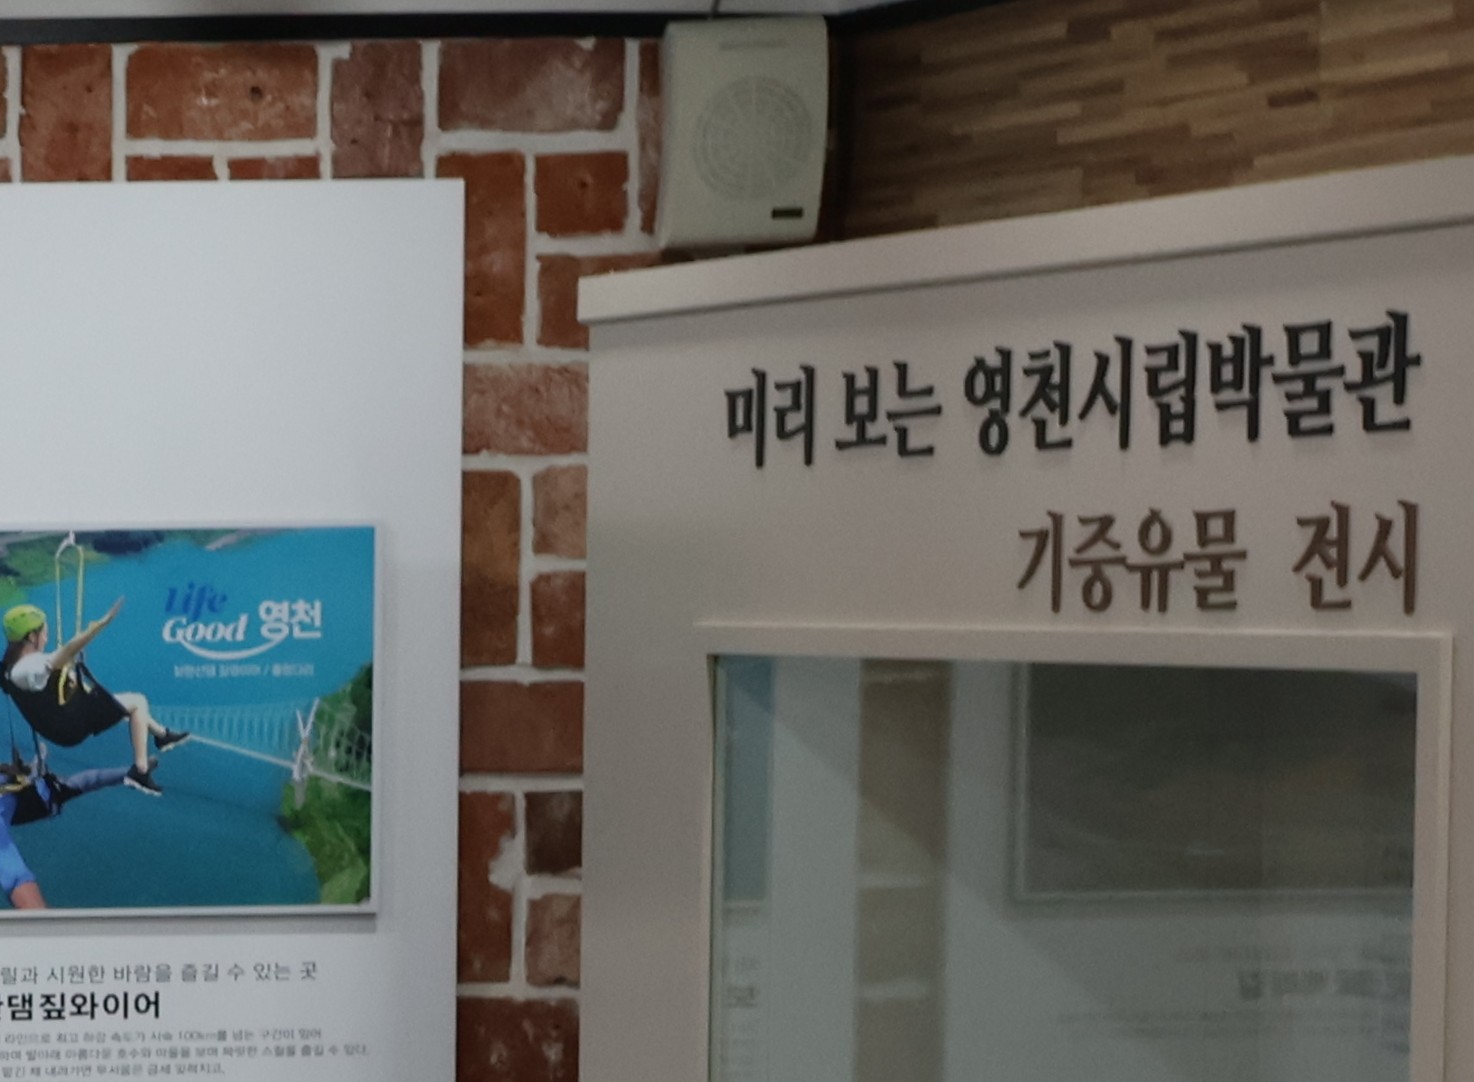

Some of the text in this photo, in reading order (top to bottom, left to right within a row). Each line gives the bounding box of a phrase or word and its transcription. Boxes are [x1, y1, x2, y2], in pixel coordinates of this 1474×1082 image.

[724, 310, 1422, 469] 미리 보는 영천시립박물관
[1017, 499, 1420, 616] 기증유물 전시
[162, 599, 322, 644] Good 영천
[46, 964, 106, 985] 시원한
[112, 963, 172, 984] 바람을
[180, 962, 220, 984] 즐길
[227, 962, 245, 982] 수
[253, 962, 291, 983] 있는
[300, 960, 318, 982] 곳
